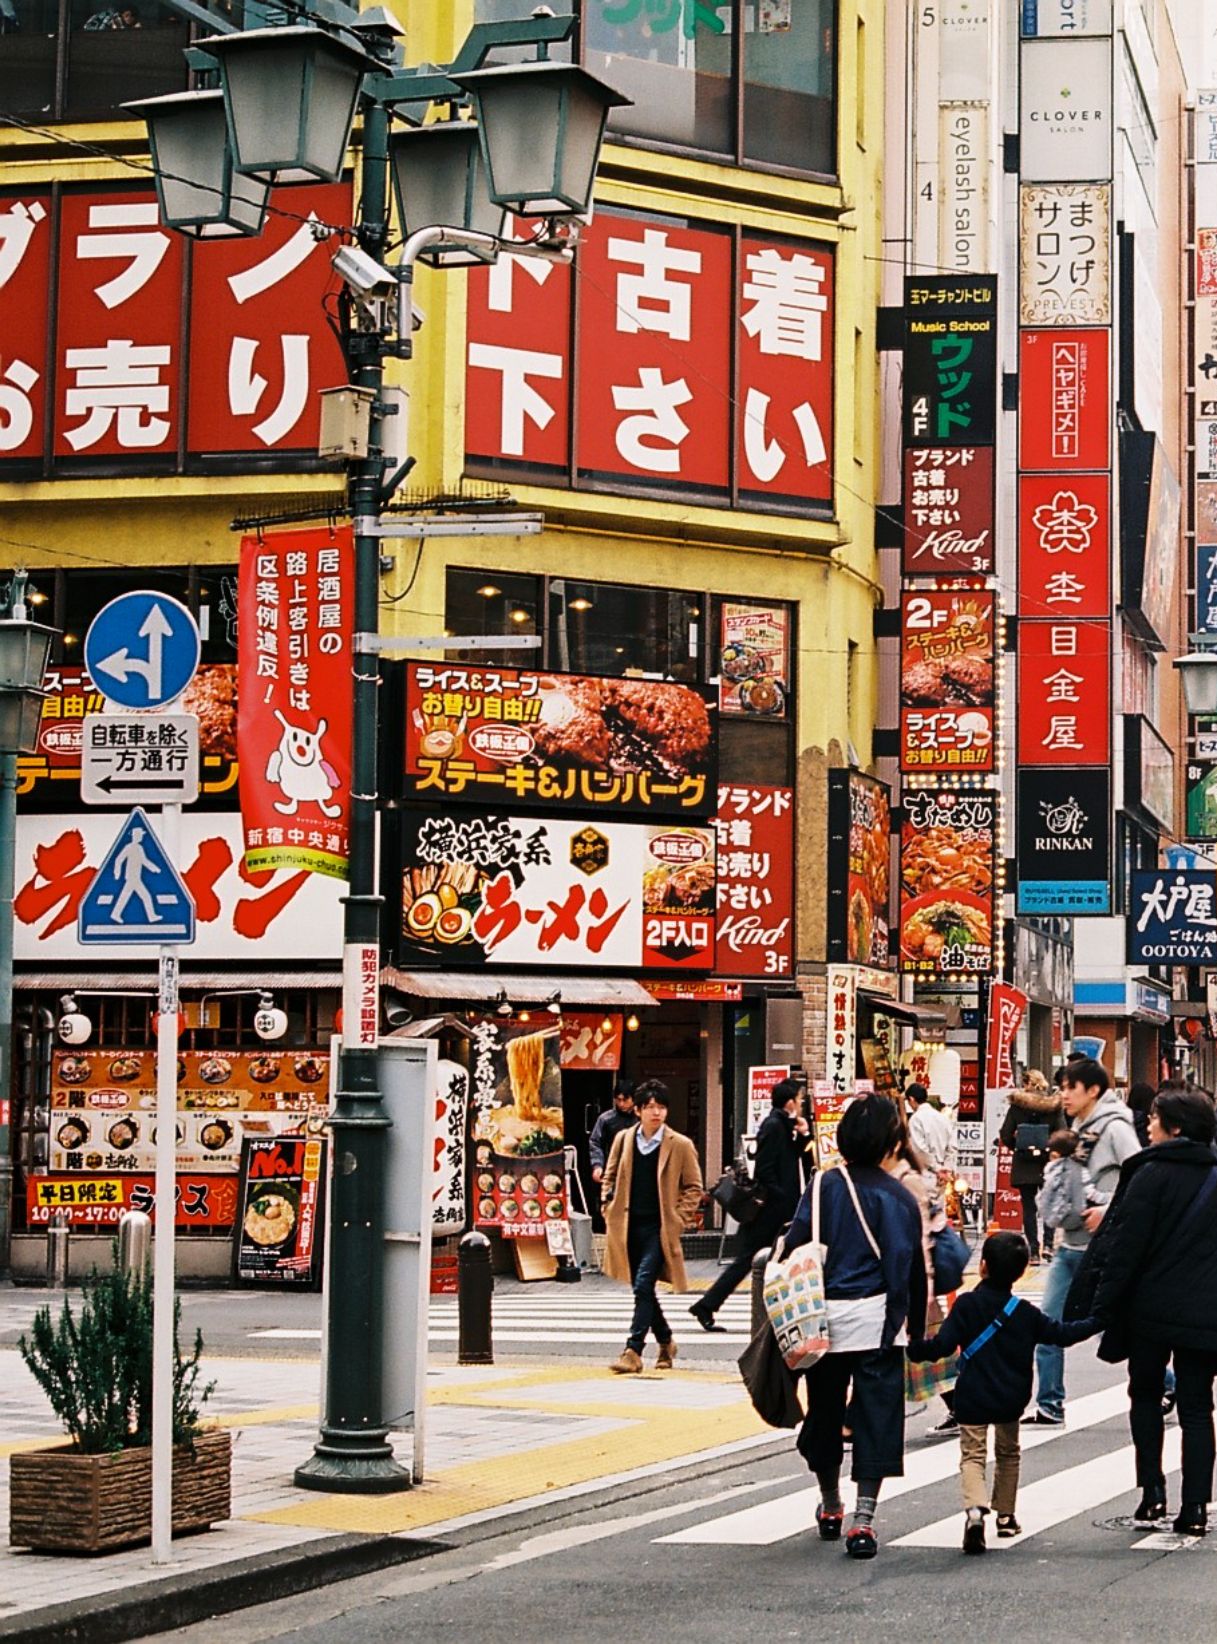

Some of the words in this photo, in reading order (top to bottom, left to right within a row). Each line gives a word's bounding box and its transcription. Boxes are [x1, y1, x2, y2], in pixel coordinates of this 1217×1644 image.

[922, 8, 935, 27] 5
[942, 17, 988, 25] CLOVER
[1030, 111, 1102, 122] CLOVER
[951, 116, 976, 201] eyelash
[920, 181, 933, 201] 4
[955, 213, 976, 266] salon
[1034, 201, 1062, 286] サロン
[1069, 201, 1095, 286] まつげ
[911, 321, 946, 333] Music
[949, 320, 990, 332] School
[932, 334, 974, 438] ウッド
[468, 342, 827, 483] 下さい
[912, 397, 929, 436] 4F
[912, 449, 975, 466] ブランド
[912, 469, 946, 487] 古着
[912, 488, 959, 506] お売り
[912, 509, 960, 527] 下さい
[912, 530, 989, 561] Kind
[971, 556, 990, 571] 3F
[317, 548, 342, 654] 居酒屋の
[906, 597, 948, 629] 2F
[286, 551, 311, 710] 路上客引きは
[416, 667, 538, 696] ライス&スープ
[91, 724, 188, 746] 自転車を除く
[906, 713, 958, 731] ライス
[906, 731, 974, 749] &スープ
[91, 750, 188, 772] 一方通行
[1187, 766, 1203, 780] 8F
[416, 758, 706, 807] ステーキ&ハンバーグ
[904, 791, 992, 829] すためし
[416, 815, 552, 866] 横浜家系
[1035, 837, 1093, 850] RINKAN
[14, 829, 313, 940] ラメン
[472, 869, 631, 954] ラーメン
[1136, 876, 1217, 933] 大戸屋
[646, 920, 708, 947] 2F入口
[716, 914, 790, 953] Kind
[763, 950, 789, 974] 3F
[1141, 944, 1213, 958] OOTOYA
[248, 1141, 306, 1178] No.1
[39, 1182, 118, 1203] 平日限定
[129, 1184, 209, 1216] ラス
